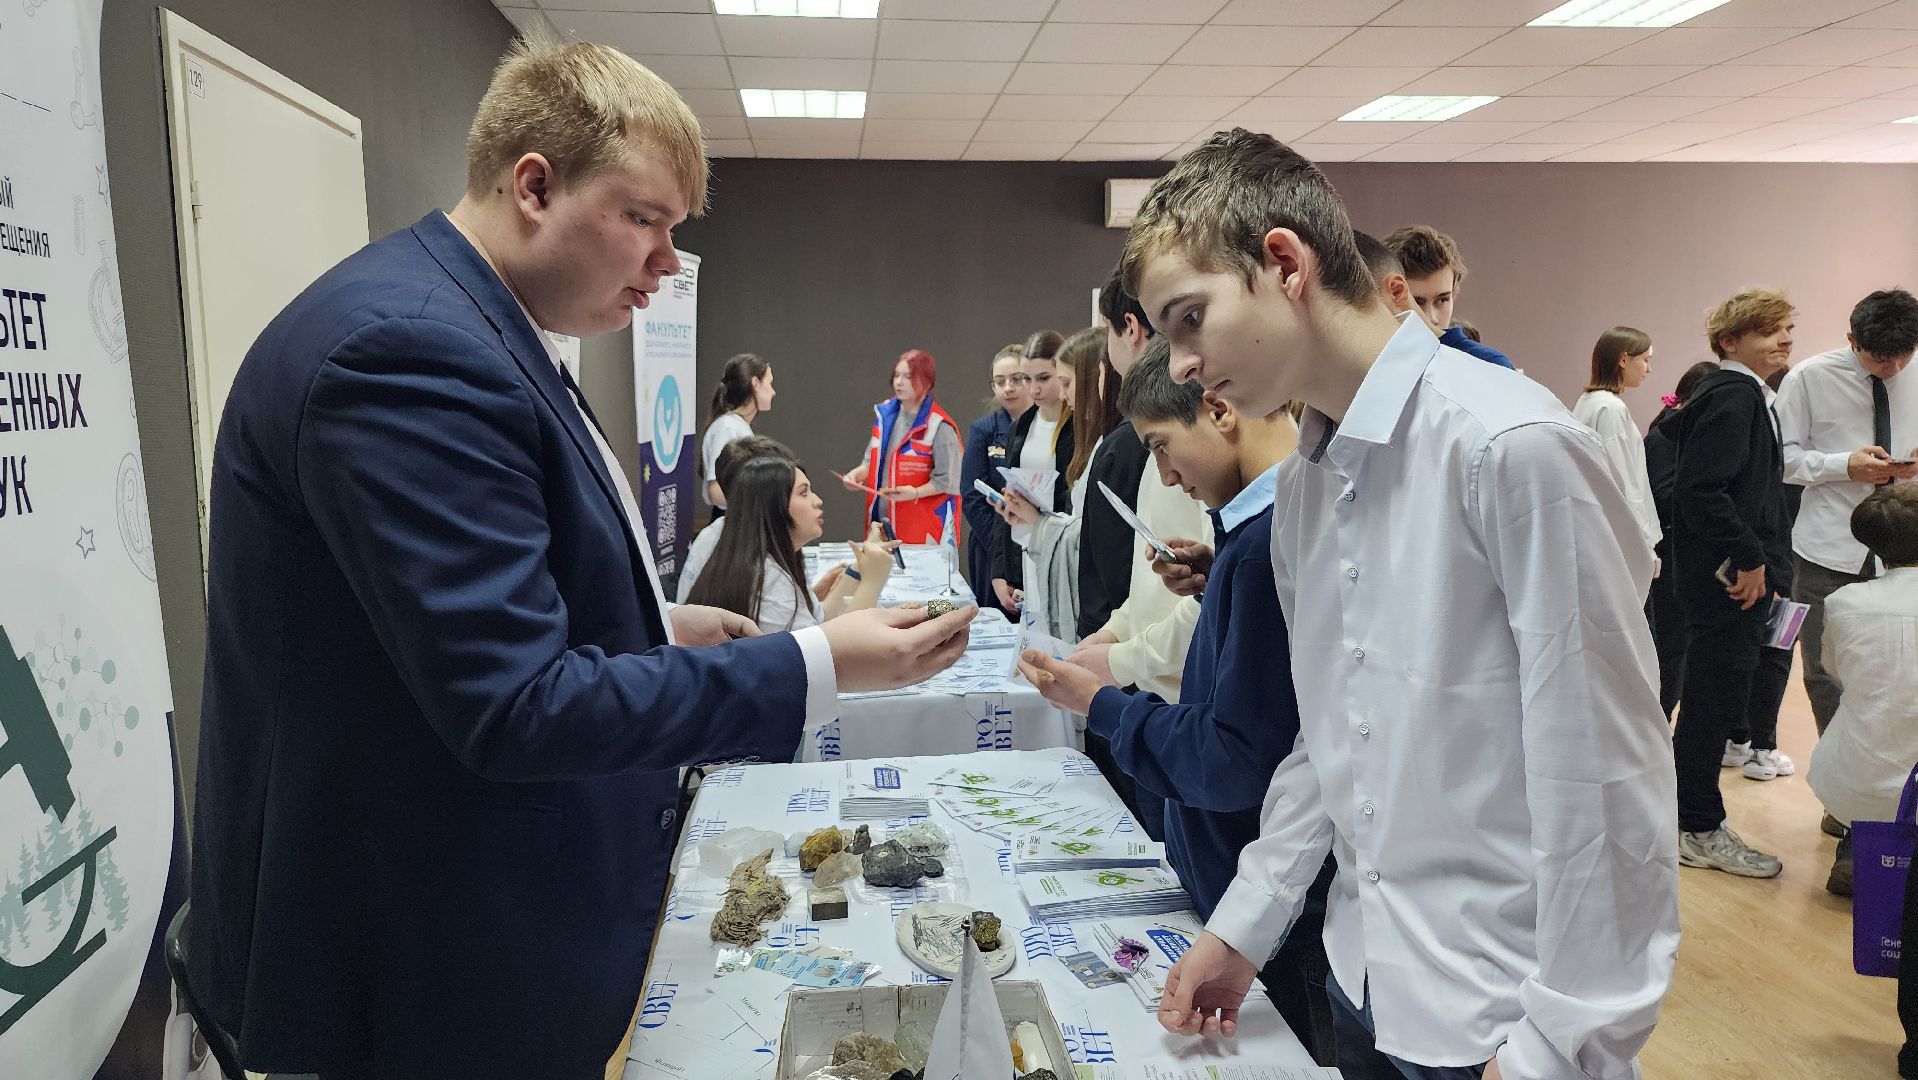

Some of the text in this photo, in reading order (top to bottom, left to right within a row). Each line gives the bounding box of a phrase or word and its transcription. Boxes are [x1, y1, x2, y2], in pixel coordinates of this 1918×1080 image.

[189, 69, 203, 90] 129
[0, 223, 50, 259] ЕЩЕНИЯ
[673, 278, 696, 291] СВЕТ
[645, 321, 693, 338] ФАКУЛЬТЕТ
[637, 979, 680, 1029] СВЕТ
